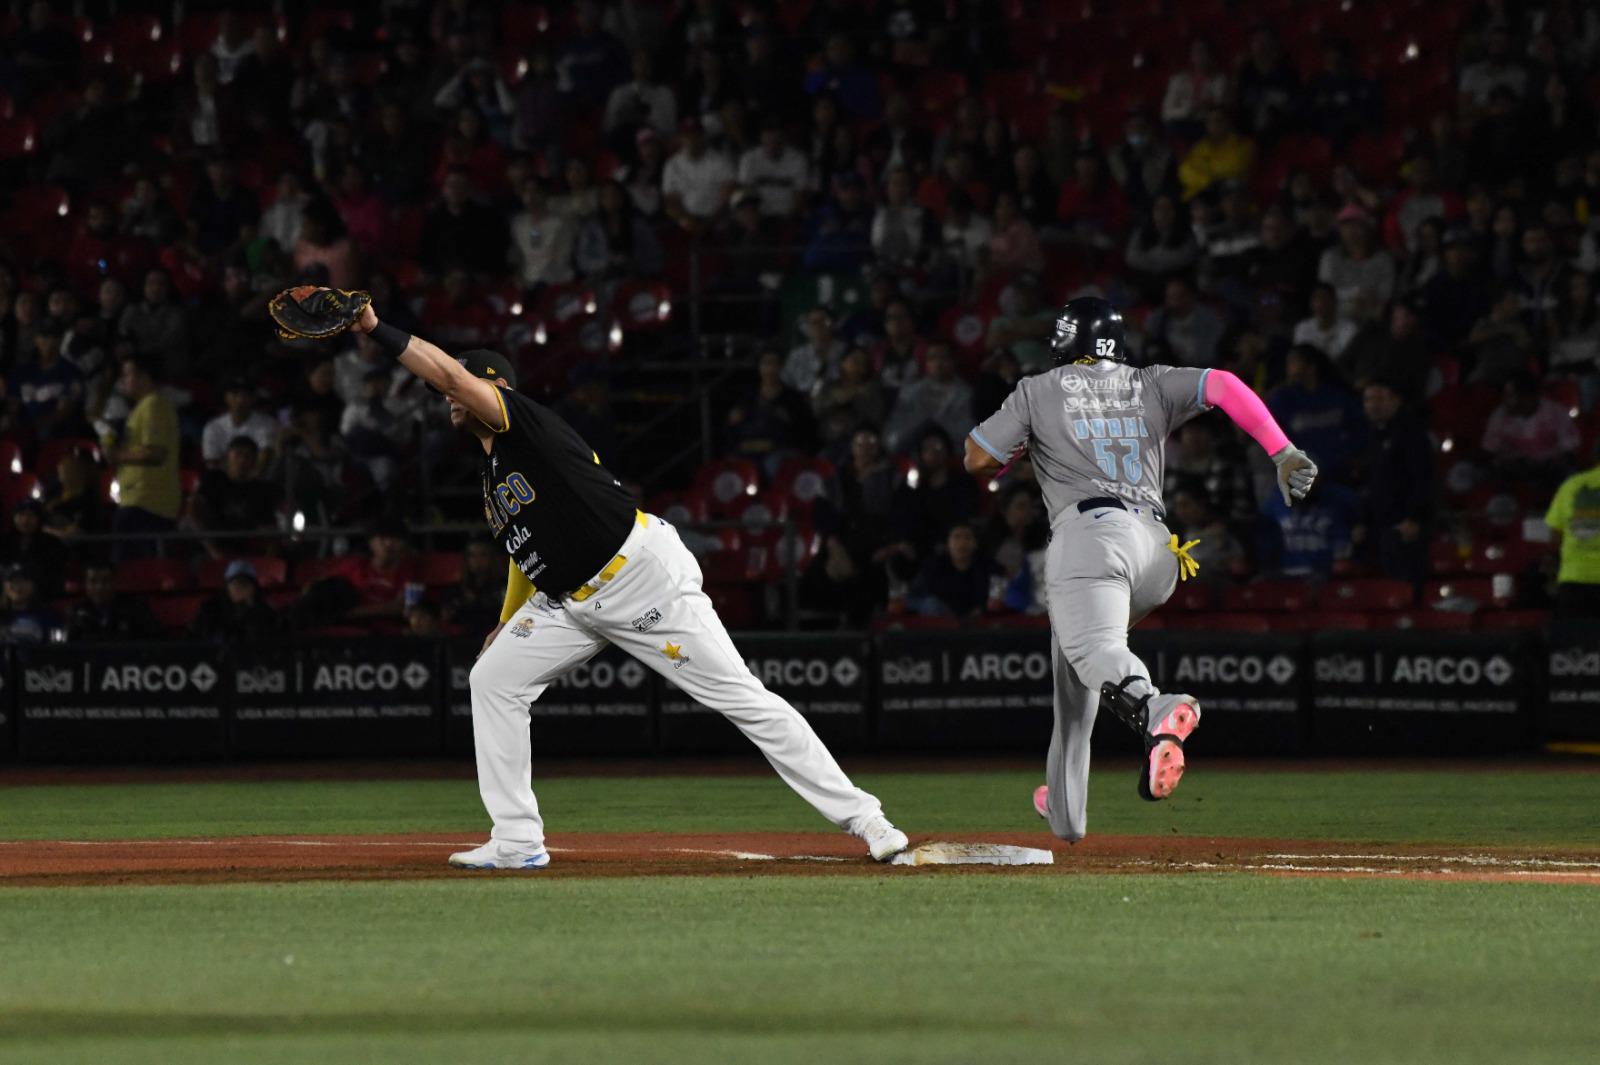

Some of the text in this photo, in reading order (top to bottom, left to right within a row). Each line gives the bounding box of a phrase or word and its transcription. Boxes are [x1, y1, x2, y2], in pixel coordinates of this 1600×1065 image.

[1096, 338, 1116, 357] 52
[1091, 438, 1142, 485] 52
[631, 607, 657, 627] GRUPO
[101, 665, 188, 692] ARCO
[313, 664, 399, 691] ARCO
[960, 652, 1049, 681] ARCO
[1174, 656, 1264, 684] ARCO
[1392, 656, 1481, 684] ARCO
